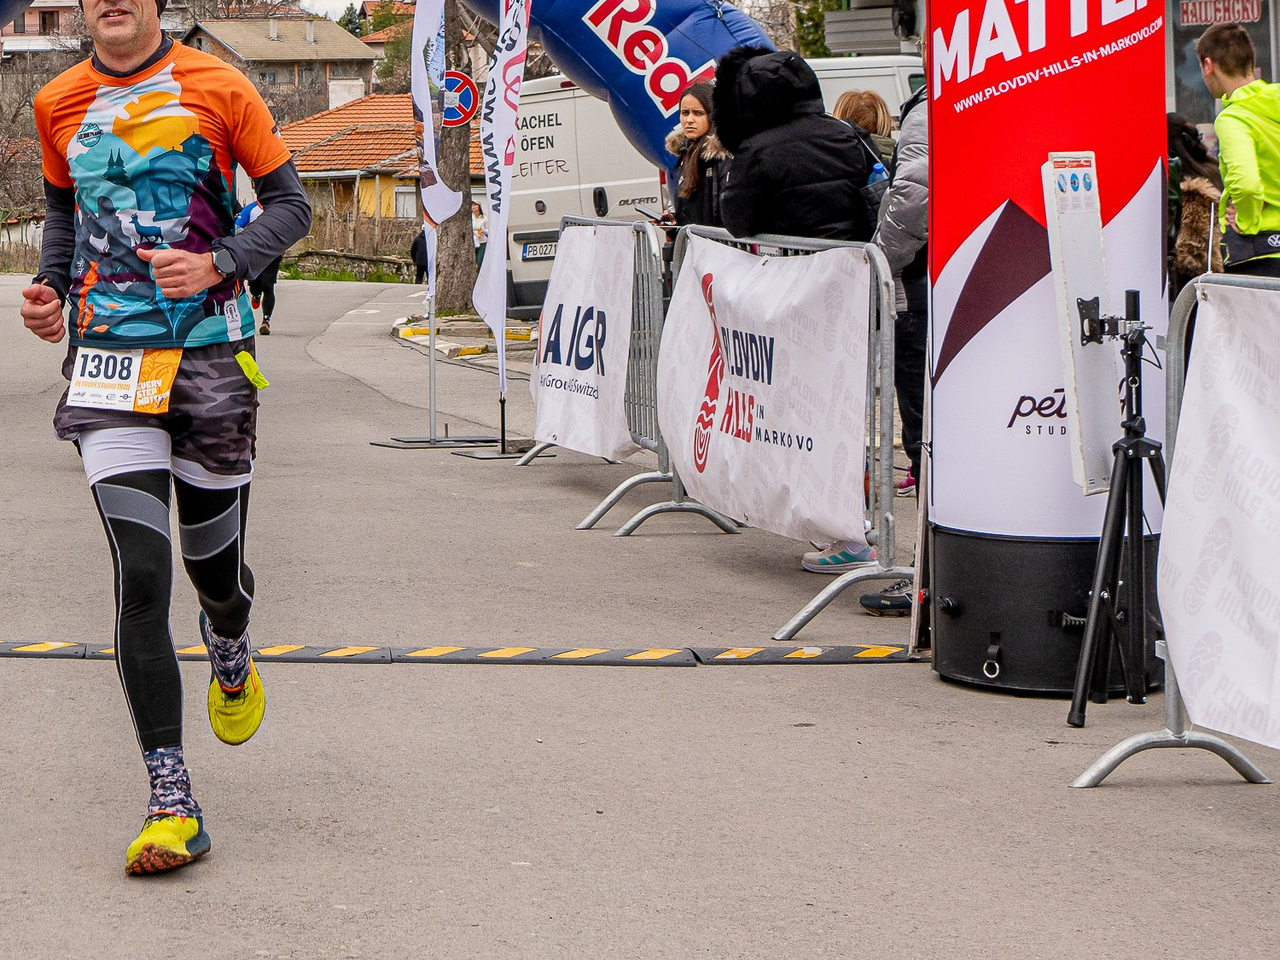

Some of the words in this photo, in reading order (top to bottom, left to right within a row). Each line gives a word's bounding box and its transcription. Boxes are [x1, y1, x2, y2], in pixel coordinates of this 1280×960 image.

[954, 15, 1163, 113] WWW.PLOVDIV-HILLS-IN-MARKOVO.COM
[521, 135, 554, 151] ÖFEN
[619, 197, 657, 206] DUCATO
[528, 246, 538, 256] PB
[80, 354, 133, 380] 1308
[137, 388, 157, 399] STEP
[756, 404, 764, 419] IN
